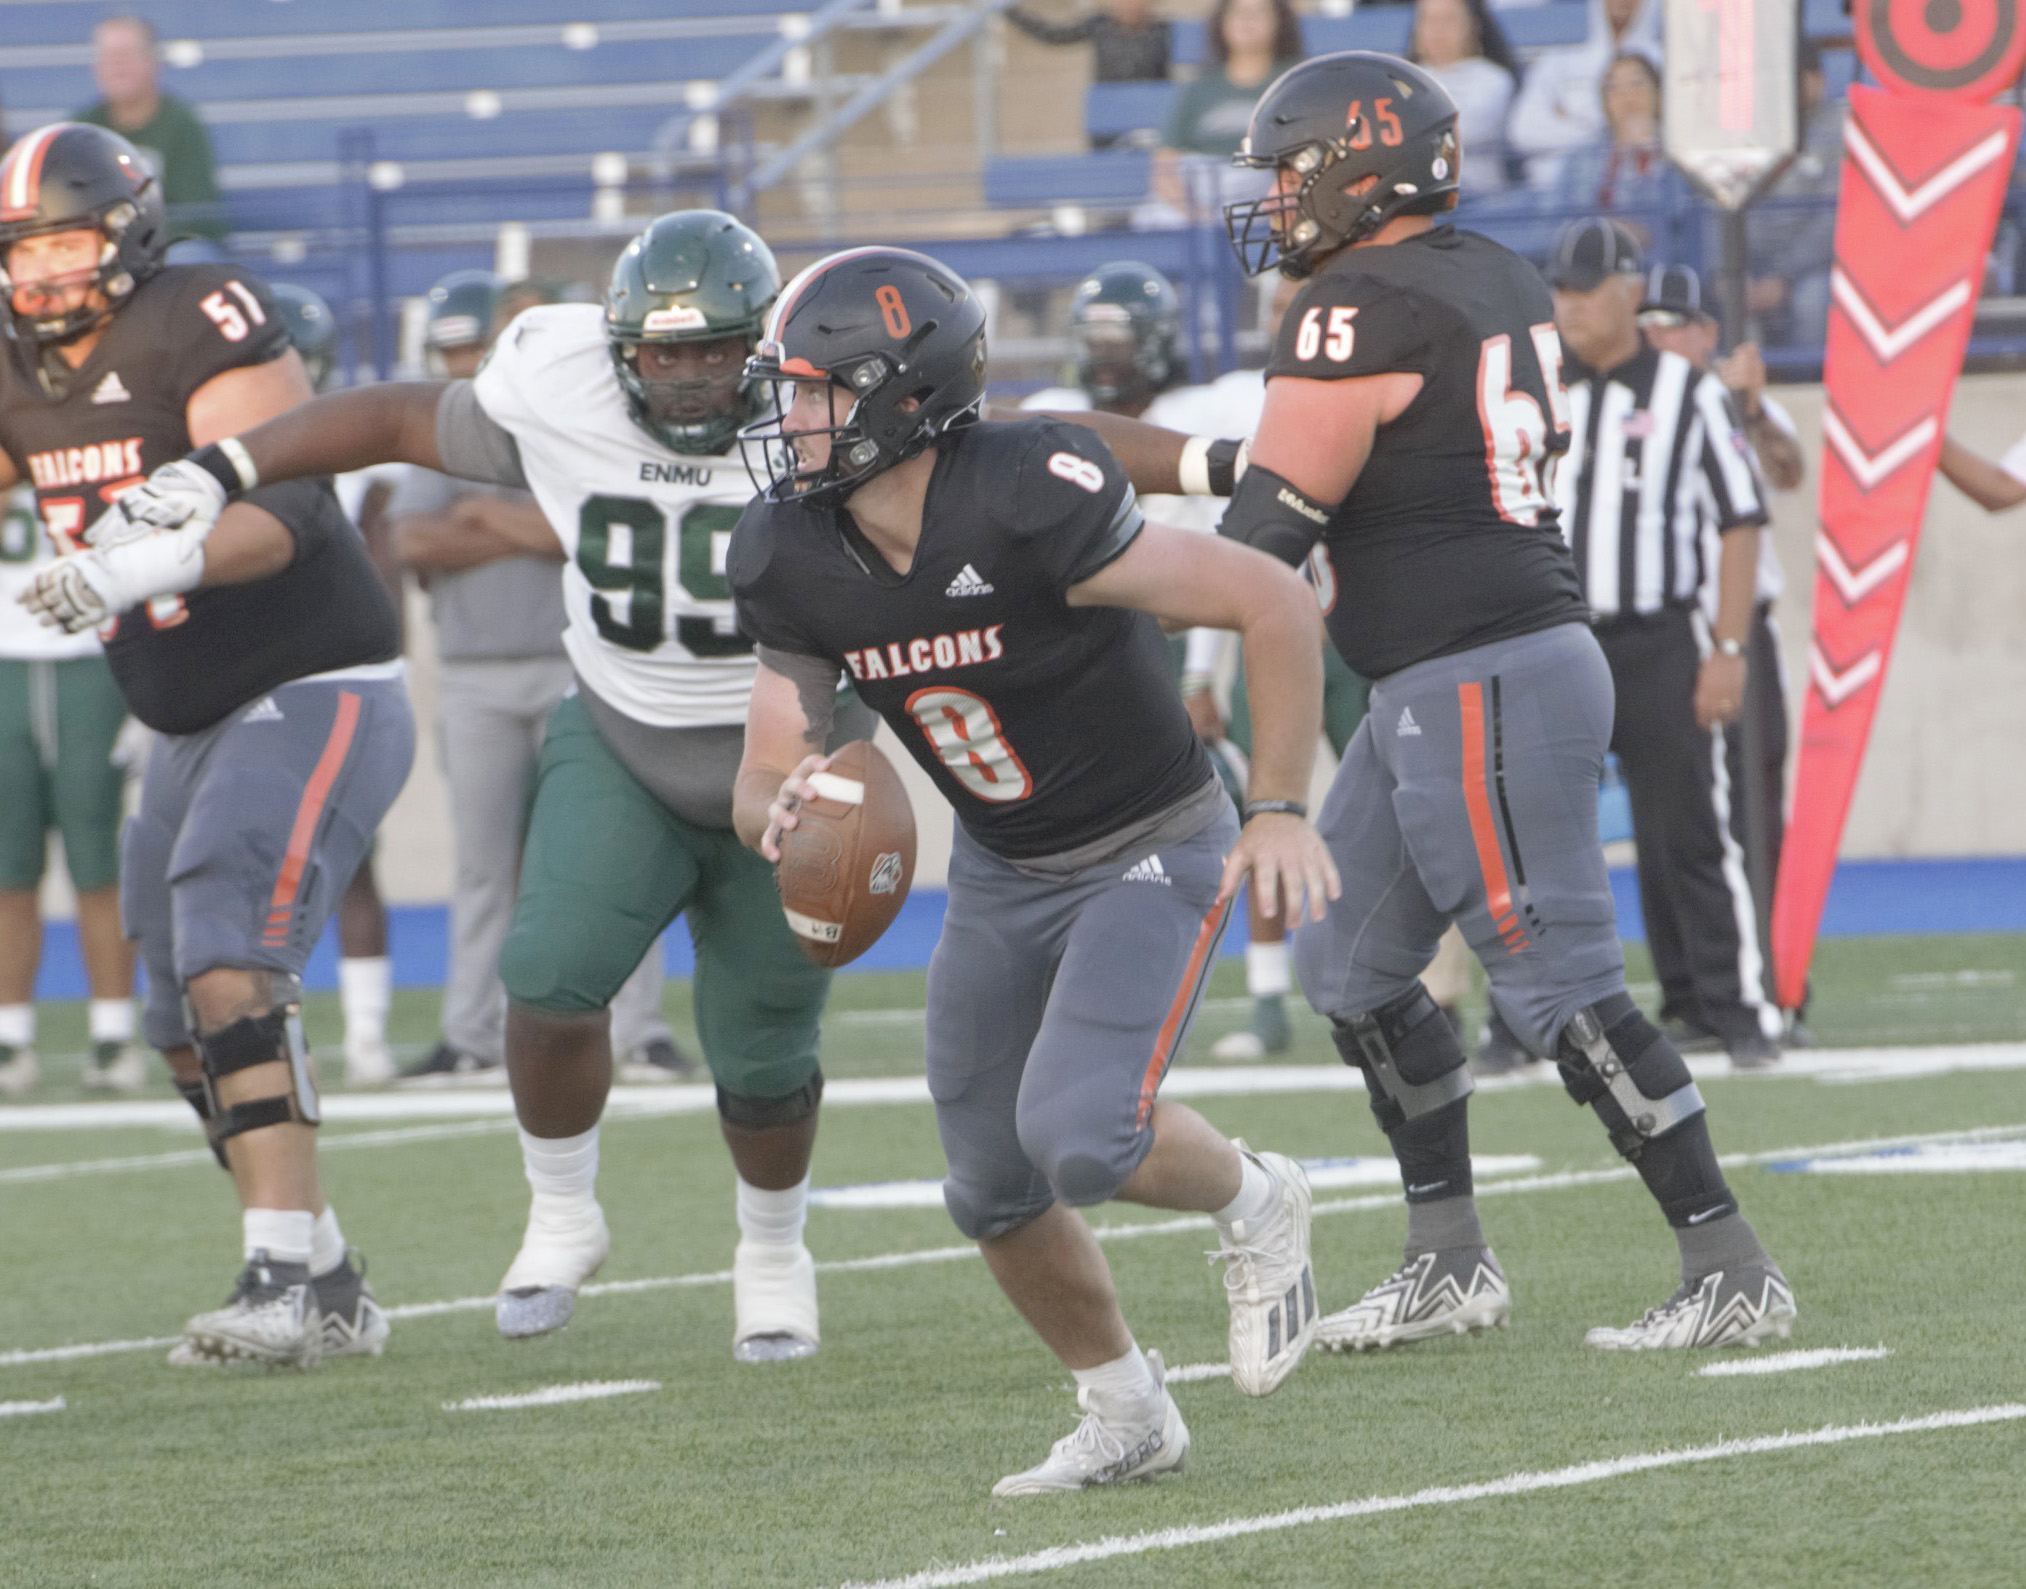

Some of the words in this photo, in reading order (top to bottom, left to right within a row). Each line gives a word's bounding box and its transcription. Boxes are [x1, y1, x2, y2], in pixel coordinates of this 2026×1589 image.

[1346, 97, 1404, 151] 65
[198, 280, 267, 342] 51
[875, 285, 912, 339] 8
[1295, 305, 1360, 362] 65
[27, 436, 145, 490] FALCONS
[639, 461, 713, 487] ENMU
[1047, 452, 1105, 494] 8
[578, 494, 757, 659] 99
[844, 623, 1004, 681] FALCONS
[904, 685, 1034, 804] 8
